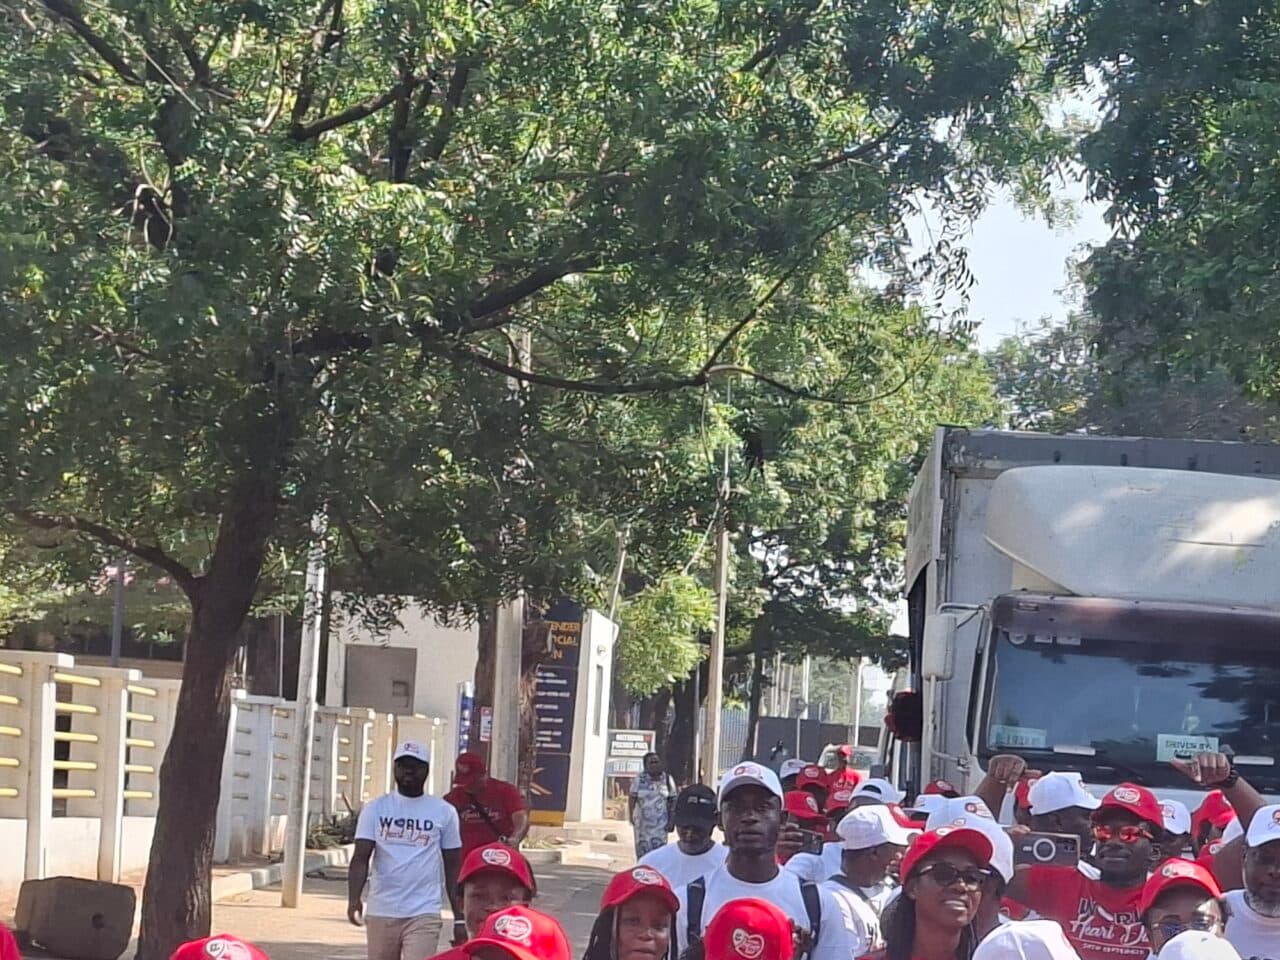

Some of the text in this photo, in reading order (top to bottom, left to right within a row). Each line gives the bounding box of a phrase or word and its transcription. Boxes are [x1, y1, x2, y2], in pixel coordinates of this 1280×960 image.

[379, 817, 434, 832] WORLD
[1070, 913, 1149, 946] Heart Da
